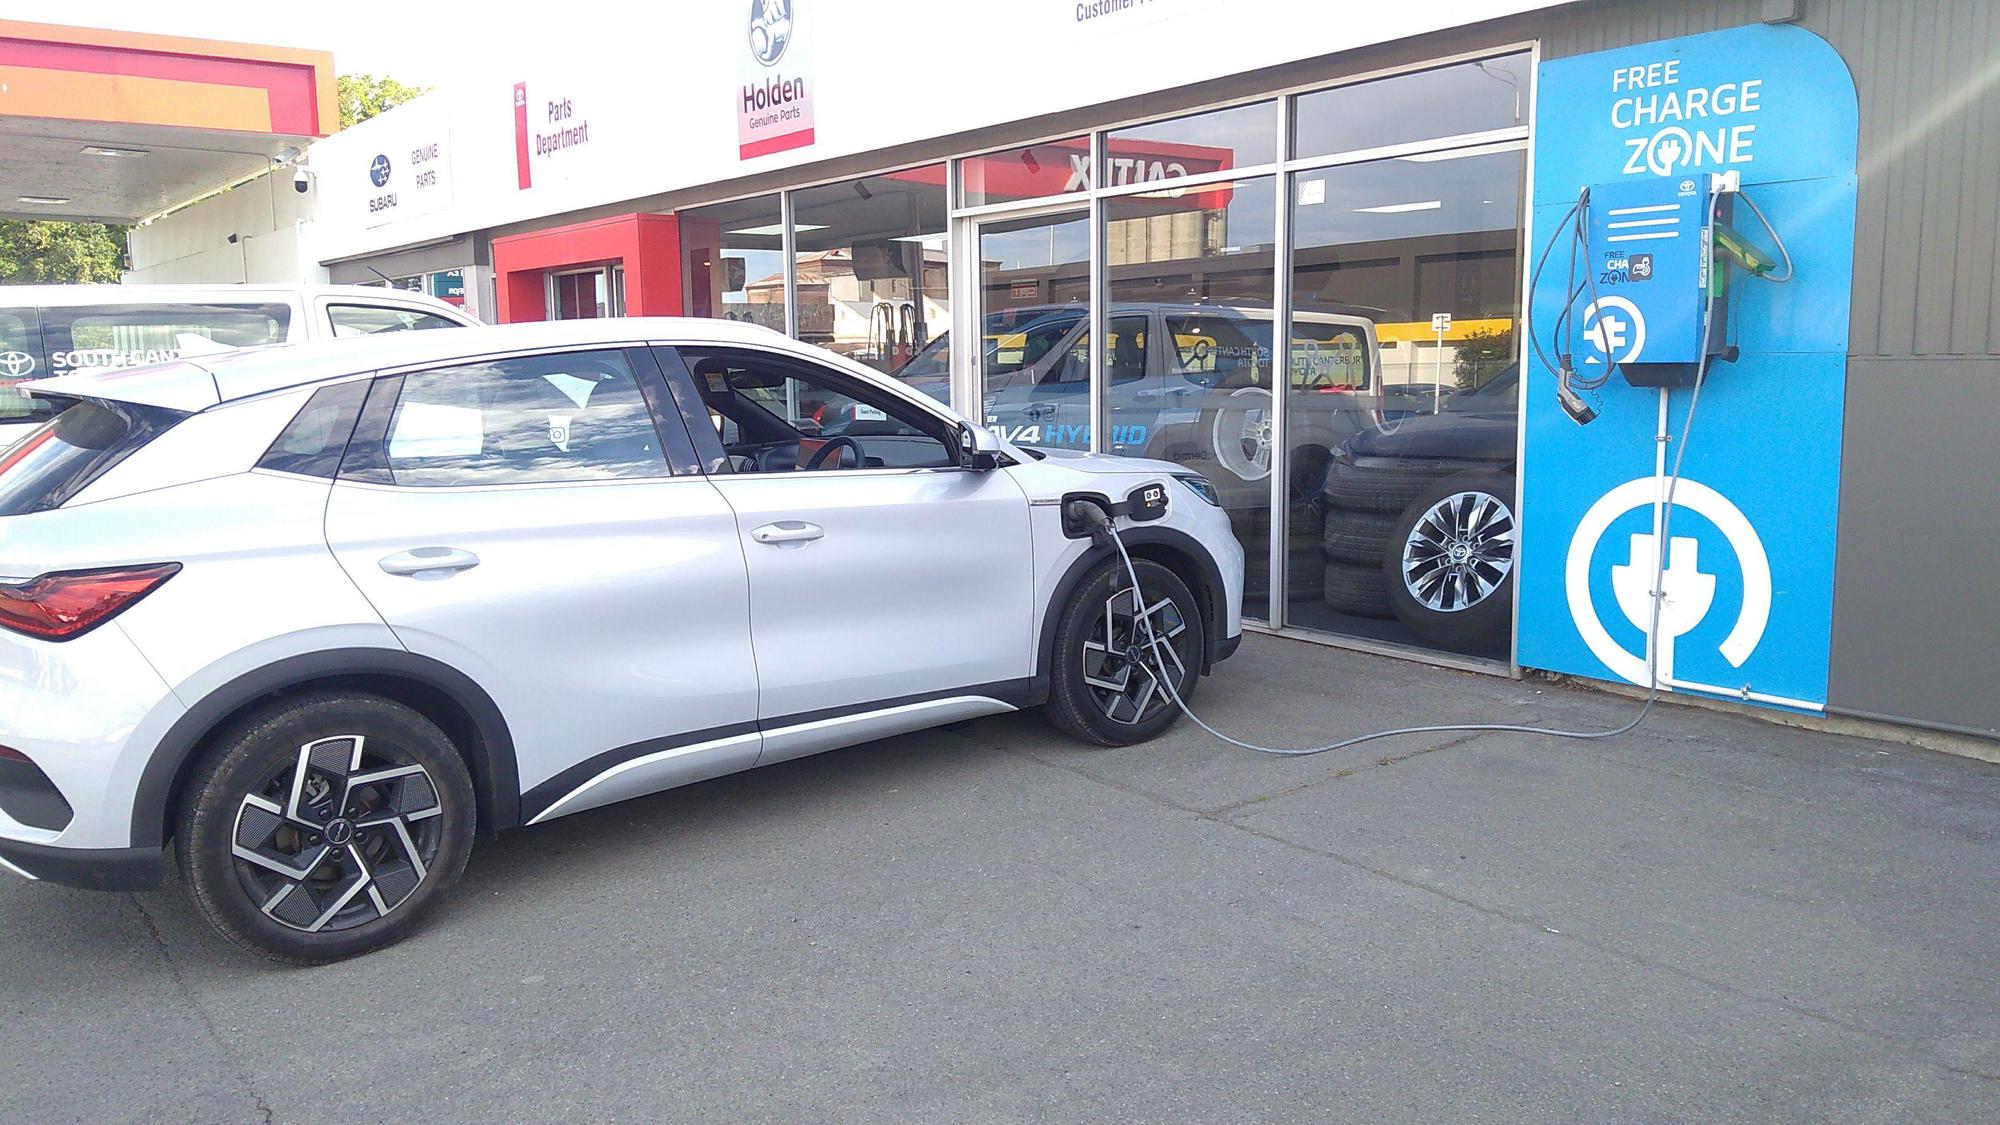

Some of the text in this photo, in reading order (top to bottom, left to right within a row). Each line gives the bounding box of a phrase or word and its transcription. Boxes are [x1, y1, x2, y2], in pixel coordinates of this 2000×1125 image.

[1612, 60, 1681, 93] FREE
[743, 73, 804, 114] Holden
[1611, 79, 1763, 129] CHARGE
[548, 97, 572, 124] Parts
[749, 106, 800, 129] Genuine Parts
[536, 120, 589, 158] Department
[412, 143, 438, 165] GENUINE
[1622, 125, 1756, 176] ZONE
[416, 170, 437, 190] PARTS
[369, 192, 398, 213] SUBARU
[1677, 190, 1697, 198] TOYOTA
[1604, 251, 1625, 259] FREE
[1607, 259, 1629, 271] CHA
[52, 350, 127, 368] SOUTH
[1312, 355, 1364, 366] CANTERBUR
[986, 424, 1147, 445] AV4 HYID
